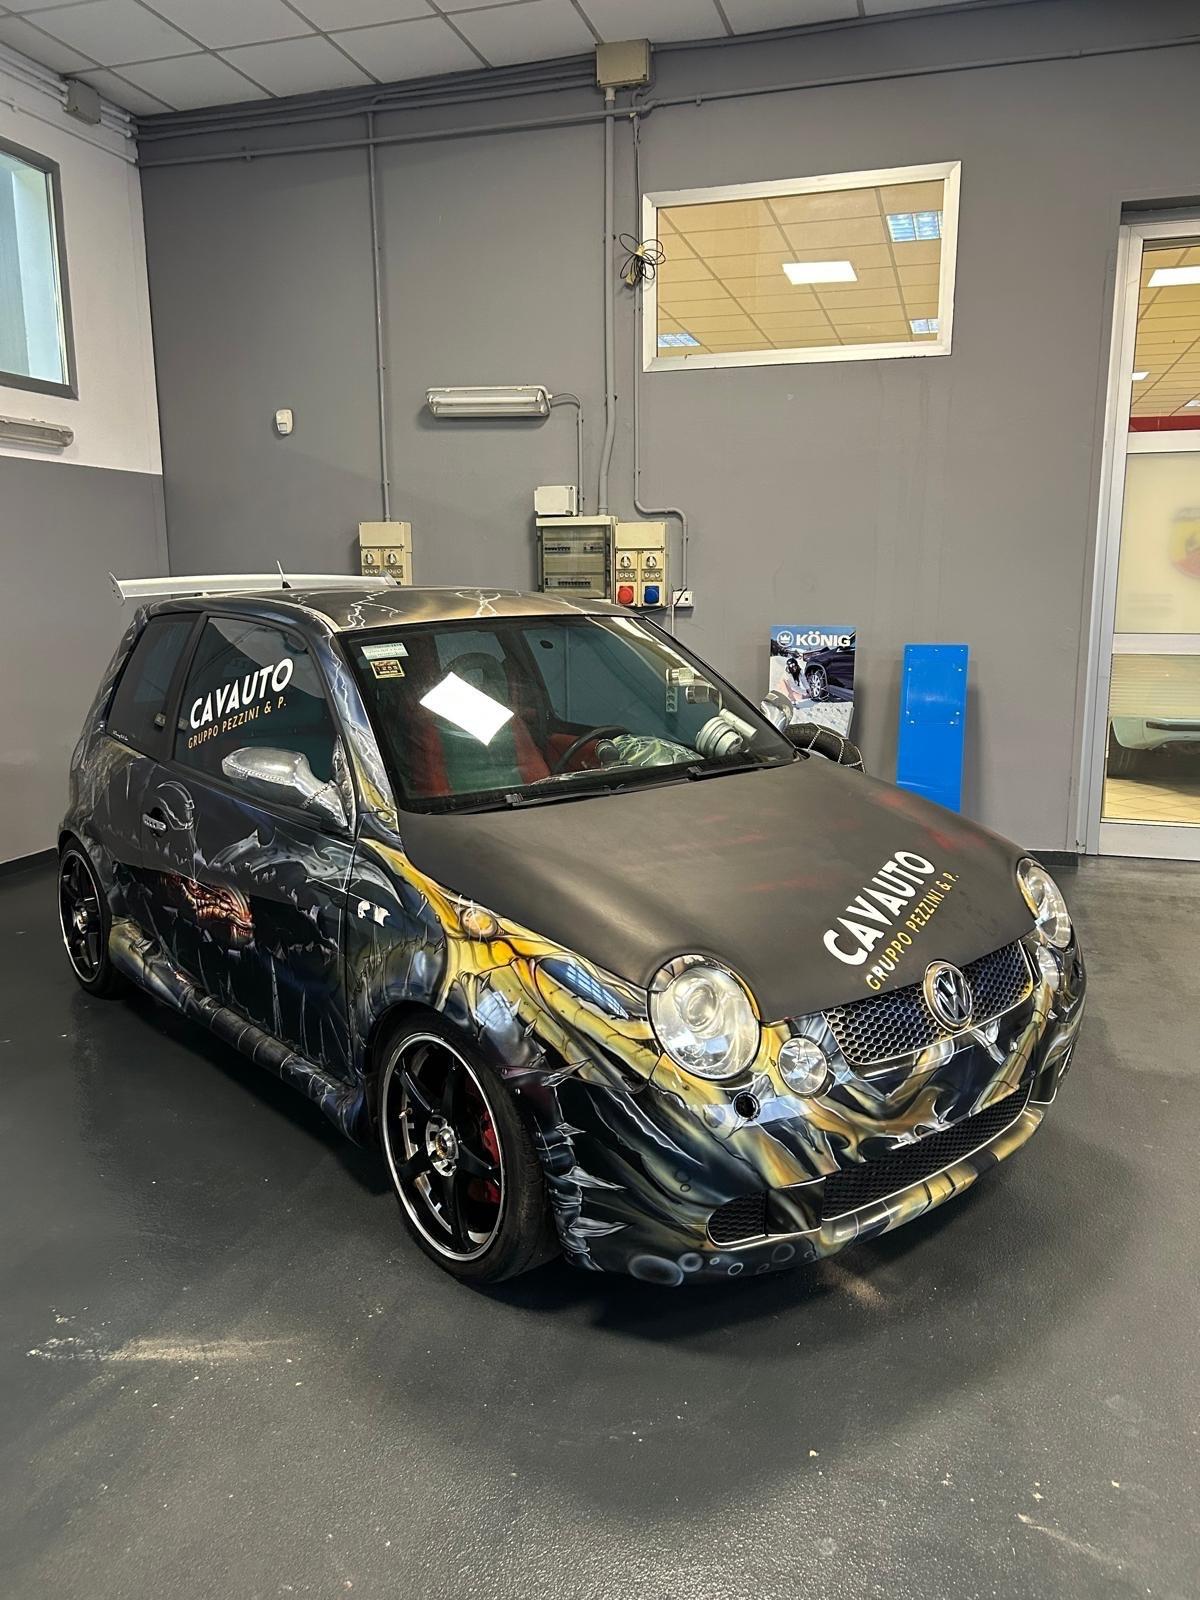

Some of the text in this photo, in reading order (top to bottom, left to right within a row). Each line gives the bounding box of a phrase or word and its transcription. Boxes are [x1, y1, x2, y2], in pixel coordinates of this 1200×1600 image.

[796, 630, 851, 647] KÖNIG
[188, 696, 287, 749] GRUPPO PEZZINI & P.
[190, 658, 294, 729] CAVAUTO
[823, 851, 936, 966] CAVAUTO
[865, 872, 960, 990] GRUPPO PEZZINI & P.
